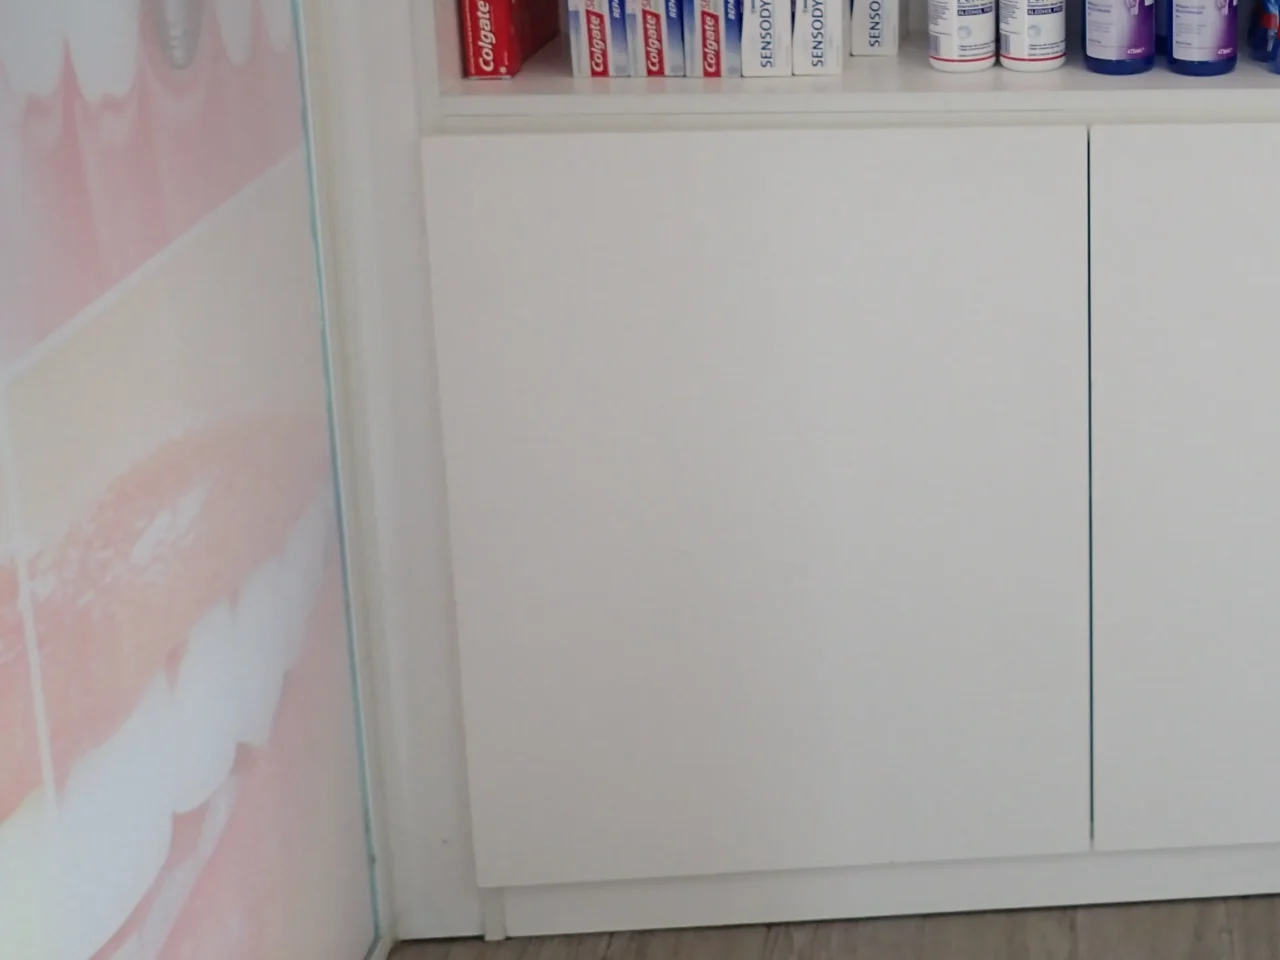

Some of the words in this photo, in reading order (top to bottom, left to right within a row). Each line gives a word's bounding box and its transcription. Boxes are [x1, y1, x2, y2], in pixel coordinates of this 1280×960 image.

[479, 0, 496, 72] Colgate
[592, 14, 605, 72] Colgate
[647, 14, 660, 72] Colgate
[705, 15, 719, 72] Colgate
